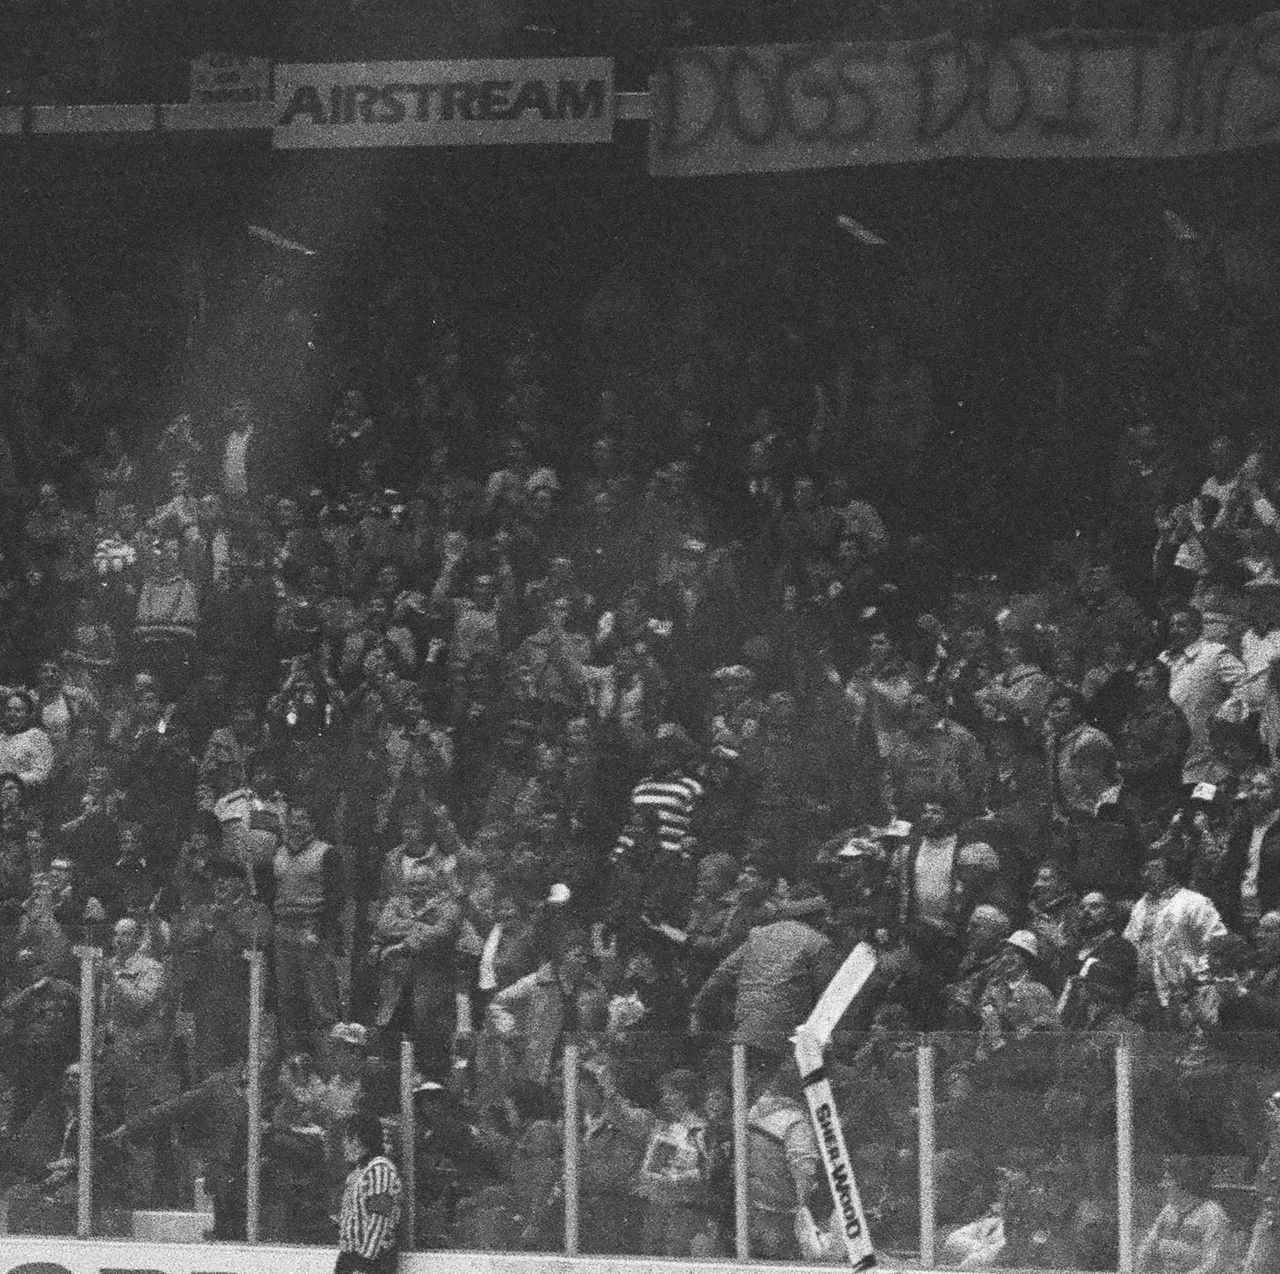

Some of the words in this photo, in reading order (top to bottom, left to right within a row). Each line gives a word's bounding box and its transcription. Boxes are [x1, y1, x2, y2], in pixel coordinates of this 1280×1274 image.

[278, 79, 607, 125] AIRSTREAM
[662, 48, 877, 154] DOGS
[915, 42, 1032, 142] DO
